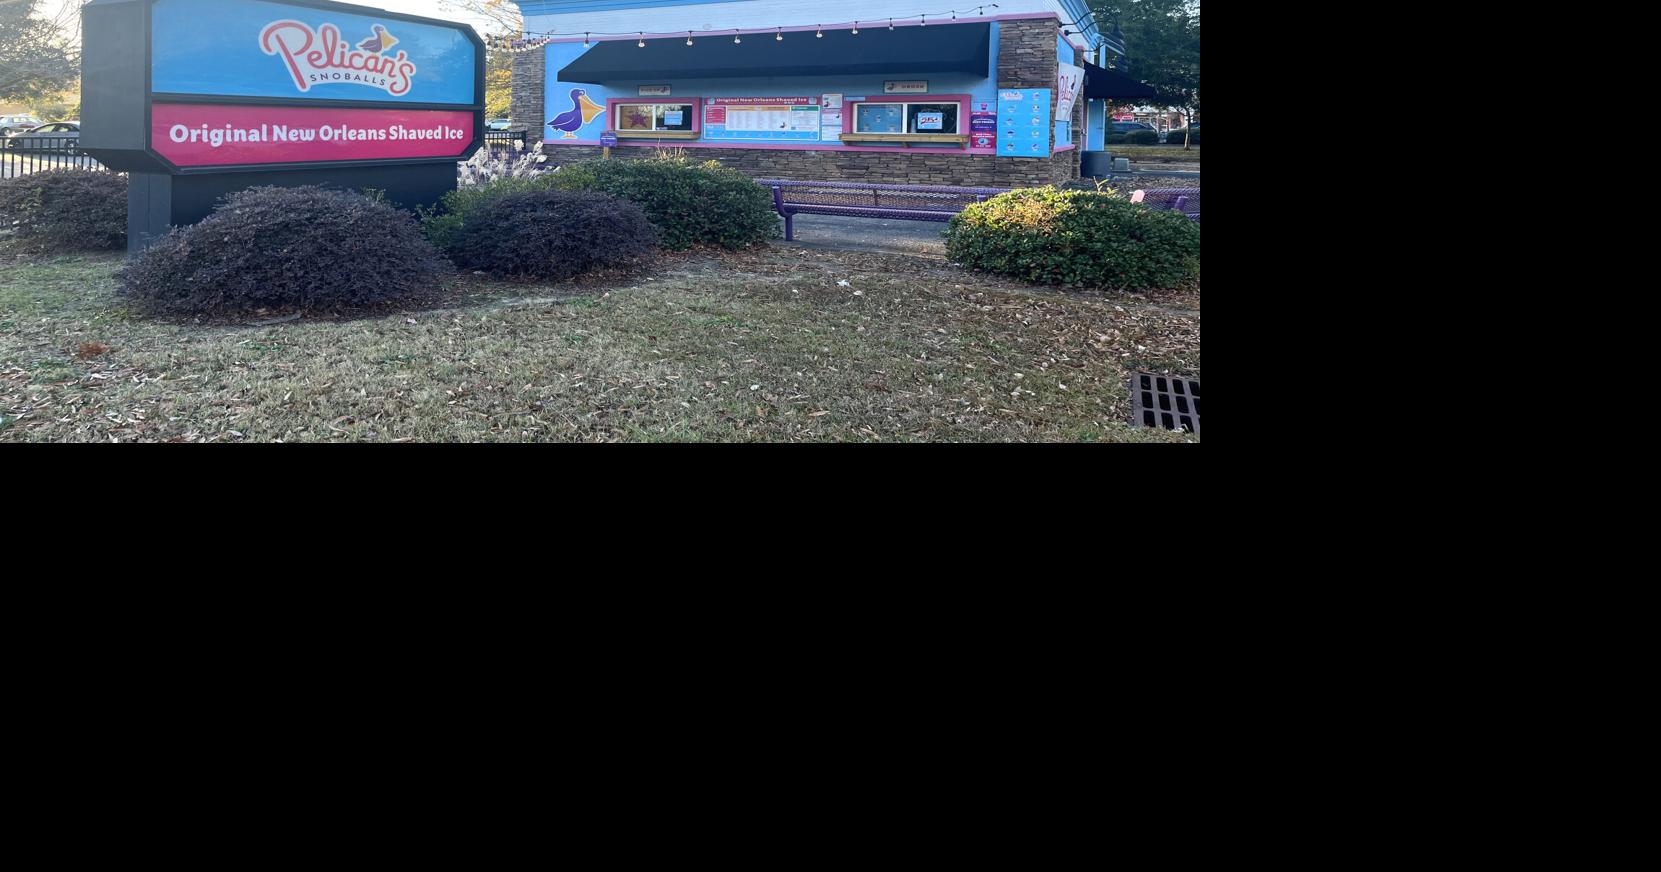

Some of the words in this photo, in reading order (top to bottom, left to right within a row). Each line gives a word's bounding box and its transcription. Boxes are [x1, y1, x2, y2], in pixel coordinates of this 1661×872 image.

[262, 21, 414, 94] Pelican's
[309, 72, 386, 86] SNOBALLS
[169, 124, 268, 147] Original
[272, 125, 316, 142] New
[319, 125, 387, 141] Orleans
[389, 125, 443, 141] Shaved
[445, 125, 464, 140] Ice
